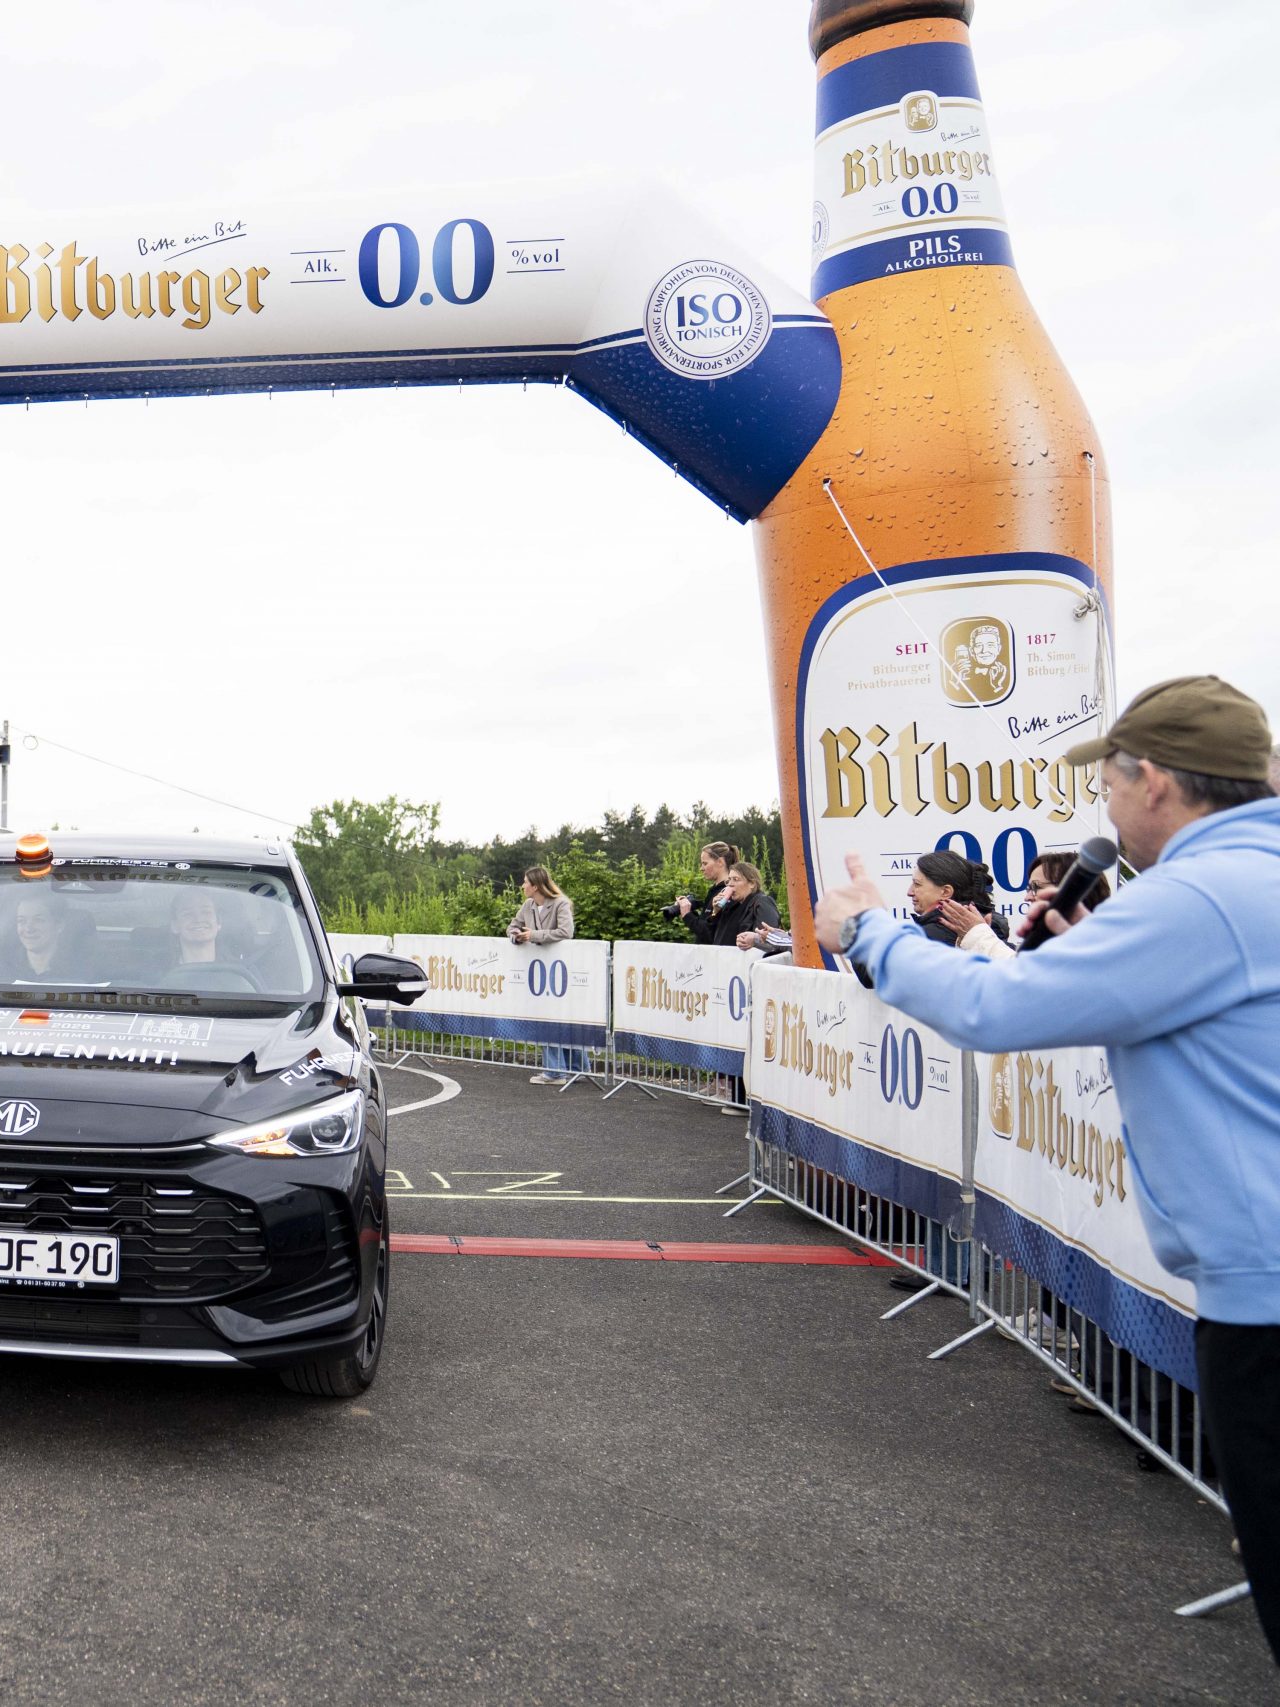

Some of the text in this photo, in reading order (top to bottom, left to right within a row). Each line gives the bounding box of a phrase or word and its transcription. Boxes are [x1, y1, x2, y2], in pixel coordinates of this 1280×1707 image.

[841, 139, 990, 198] Bitburger
[901, 182, 958, 218] 0.0
[137, 220, 247, 256] Bitte ein Bit
[908, 235, 961, 258] PILS
[304, 259, 338, 274] Alk.
[358, 218, 495, 309] 0.0
[885, 252, 983, 273] ALKOHOLFREI
[652, 265, 763, 371] EMPFOHLEN VOM DEUTSCHEN INSTITUT FÜR SPORTERNÄHRUNG
[676, 293, 742, 328] ISO
[676, 326, 742, 342] TONISCH
[896, 634, 1056, 656] SEIT 1817
[1027, 651, 1076, 663] Th. Simon
[848, 676, 931, 692] Privatbrauerei
[873, 662, 931, 677] Bitburger
[1027, 666, 1066, 677] Bitburg
[1008, 716, 1050, 739] Bitte
[1056, 712, 1078, 724] ein
[819, 721, 1108, 823] Bitburge
[428, 955, 505, 999] Bitburger
[528, 959, 569, 998] 0.0
[640, 966, 709, 1022] Bitburger
[49, 1012, 106, 1021] MAINZ
[7, 1030, 209, 1047] WWW.FIRMENLAUF-MAINZ.DE
[107, 1047, 180, 1066] MIT!
[880, 1023, 924, 1111] 0.0
[1016, 1052, 1127, 1207] Bitburger
[47, 1240, 113, 1277] 190
